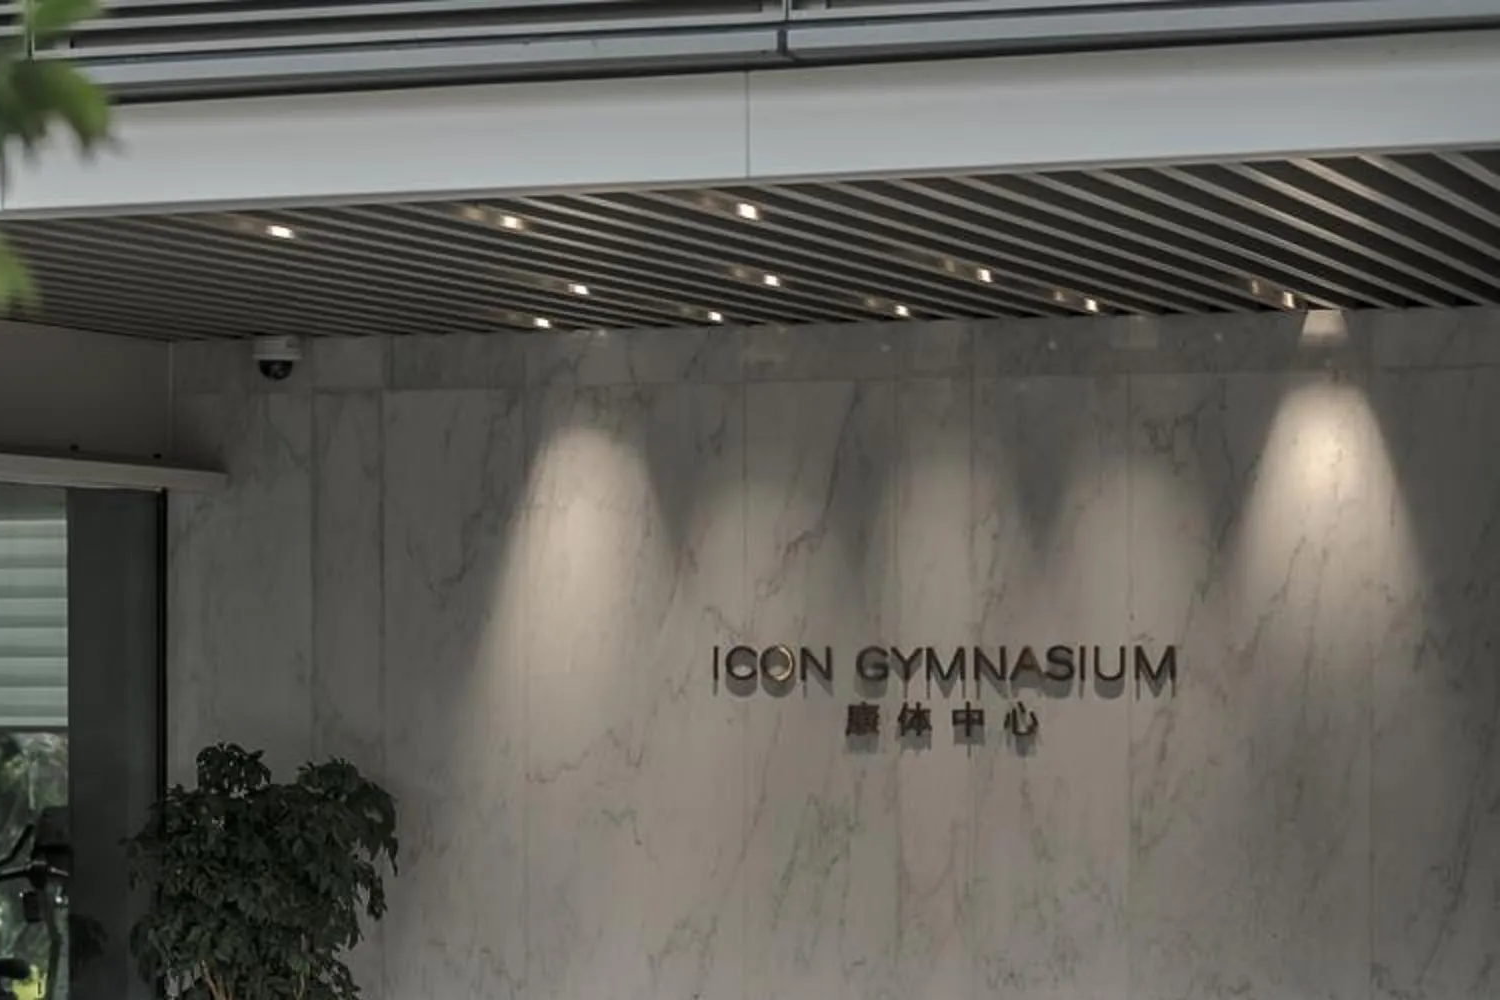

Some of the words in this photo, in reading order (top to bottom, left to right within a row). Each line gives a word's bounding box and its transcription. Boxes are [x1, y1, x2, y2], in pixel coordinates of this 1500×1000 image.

[713, 645, 833, 682] ICON
[856, 645, 1177, 682] GYMNASIUM
[845, 701, 1038, 737] 康体中心
